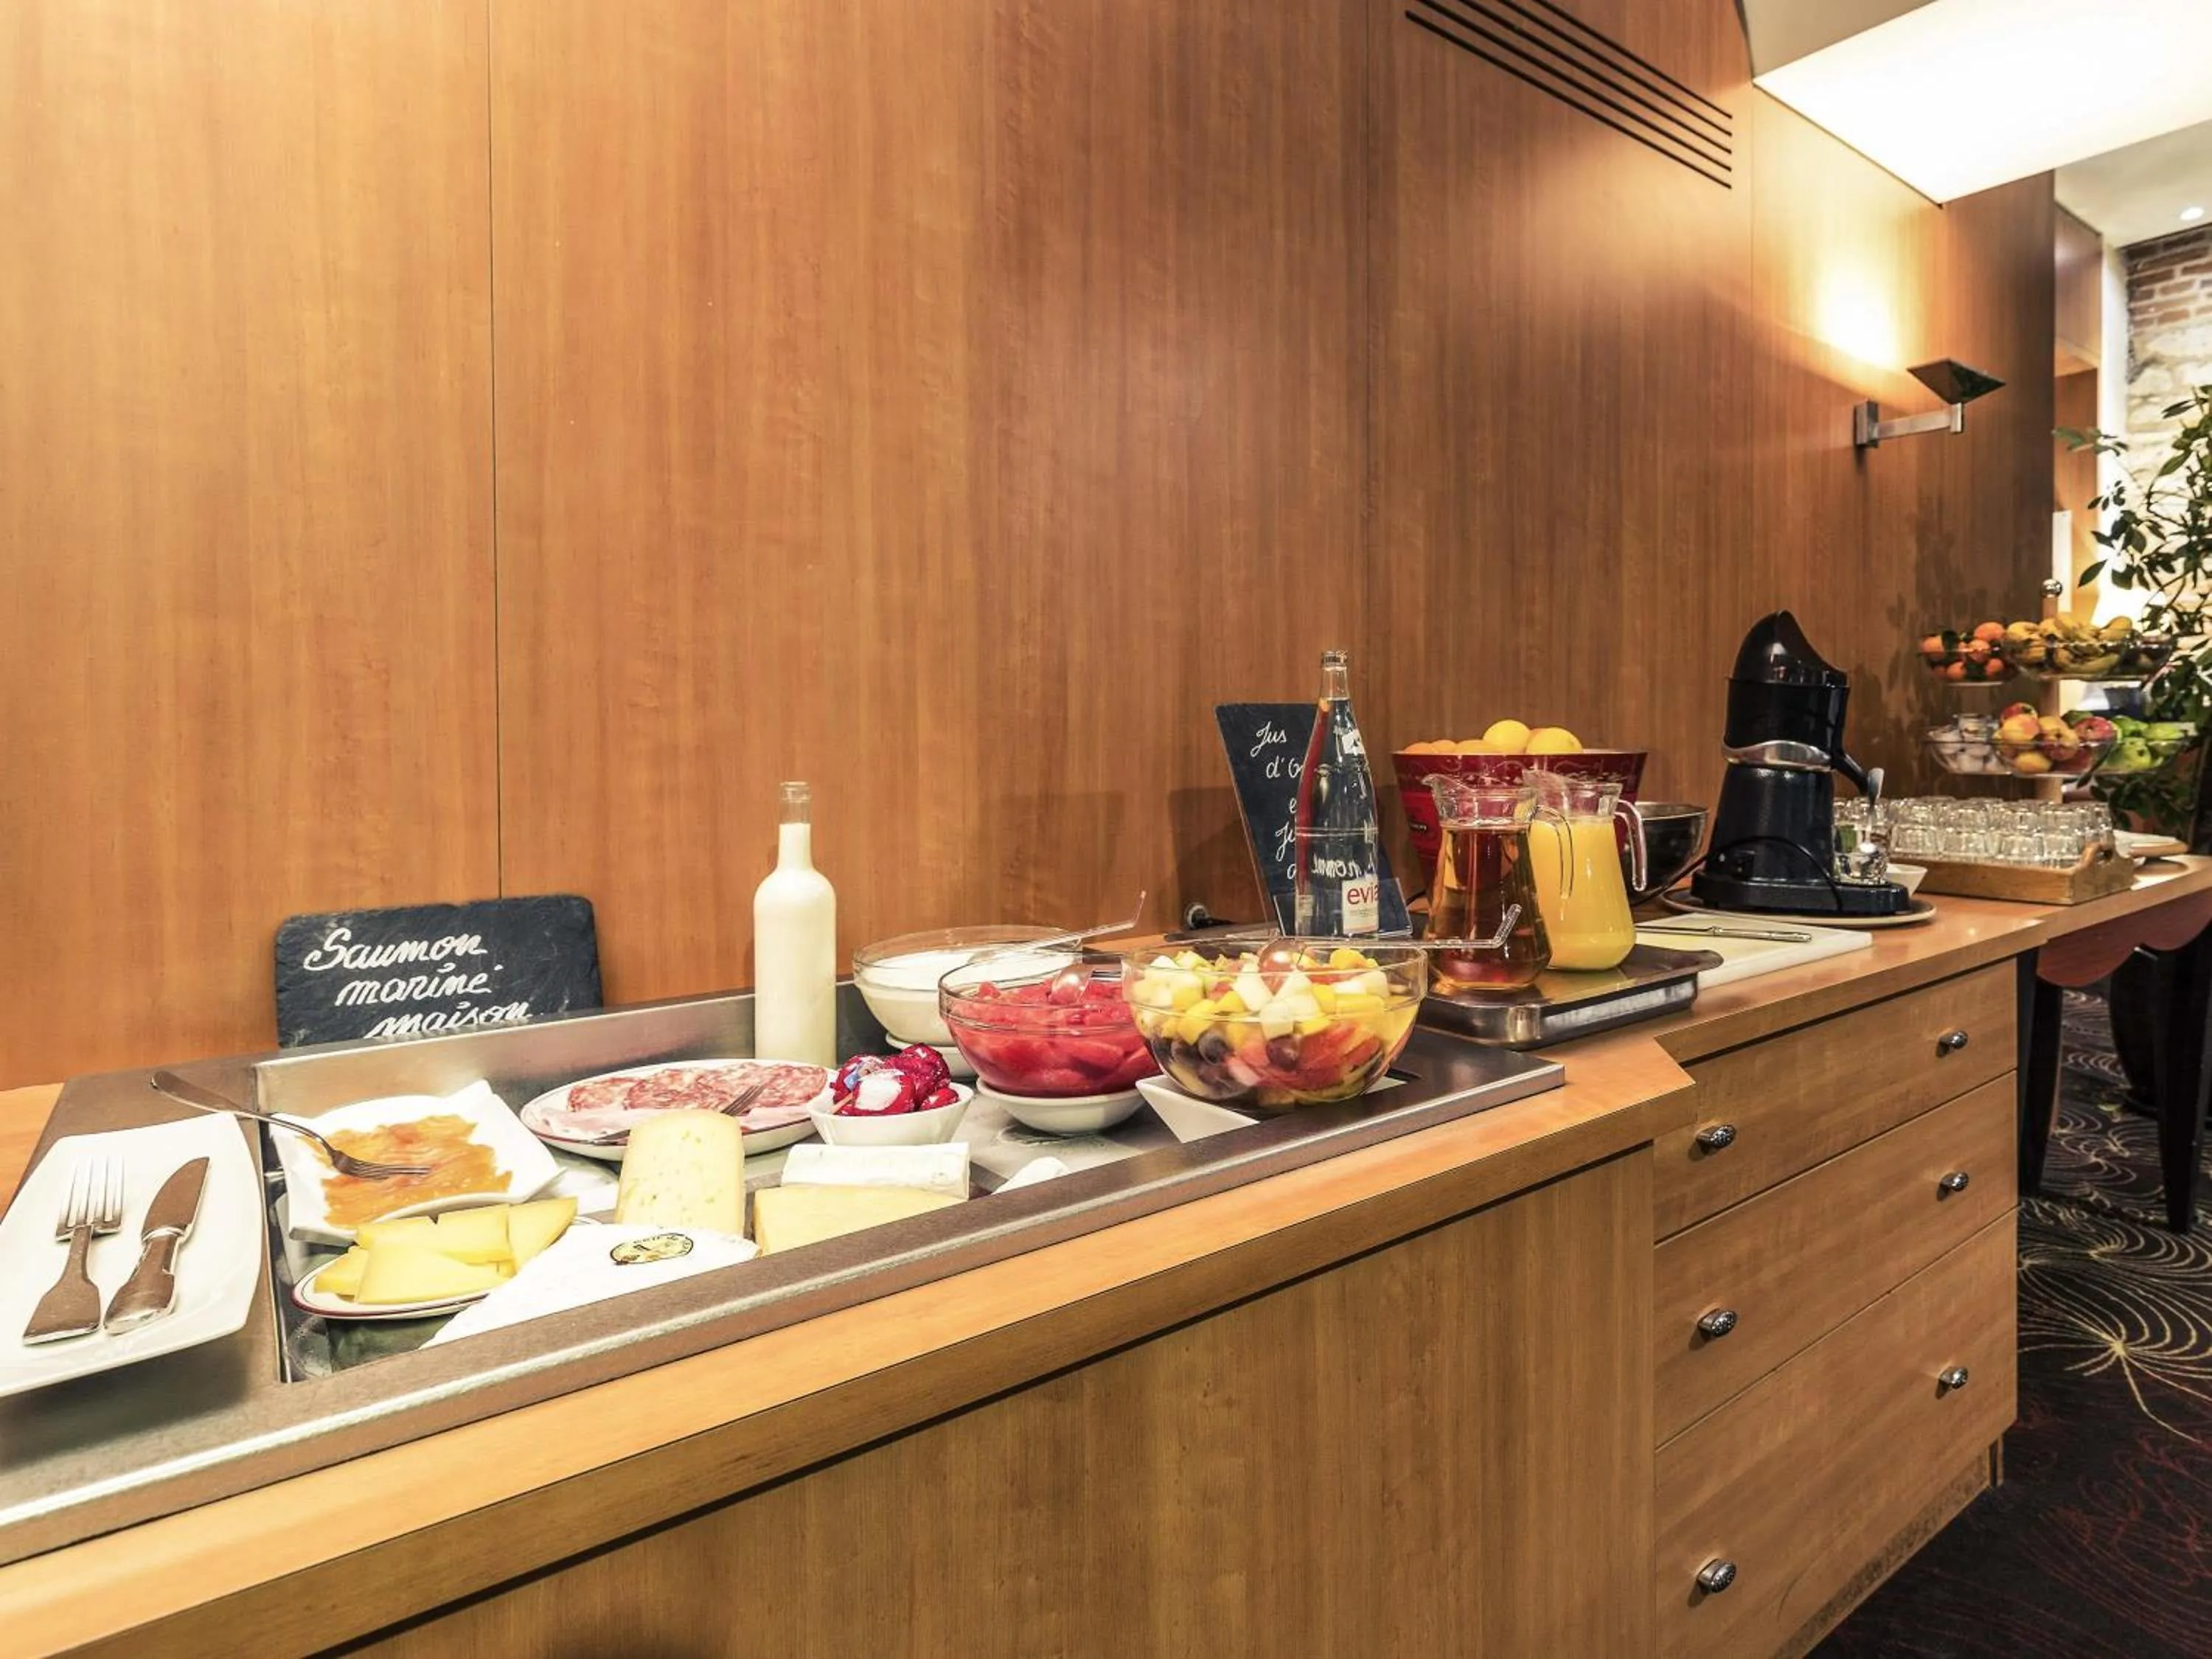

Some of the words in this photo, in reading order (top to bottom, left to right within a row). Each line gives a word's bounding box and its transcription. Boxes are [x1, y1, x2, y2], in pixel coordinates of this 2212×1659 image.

[1251, 720, 1287, 757] Jus
[304, 928, 488, 971] Saumon
[364, 999, 533, 1039] maison
